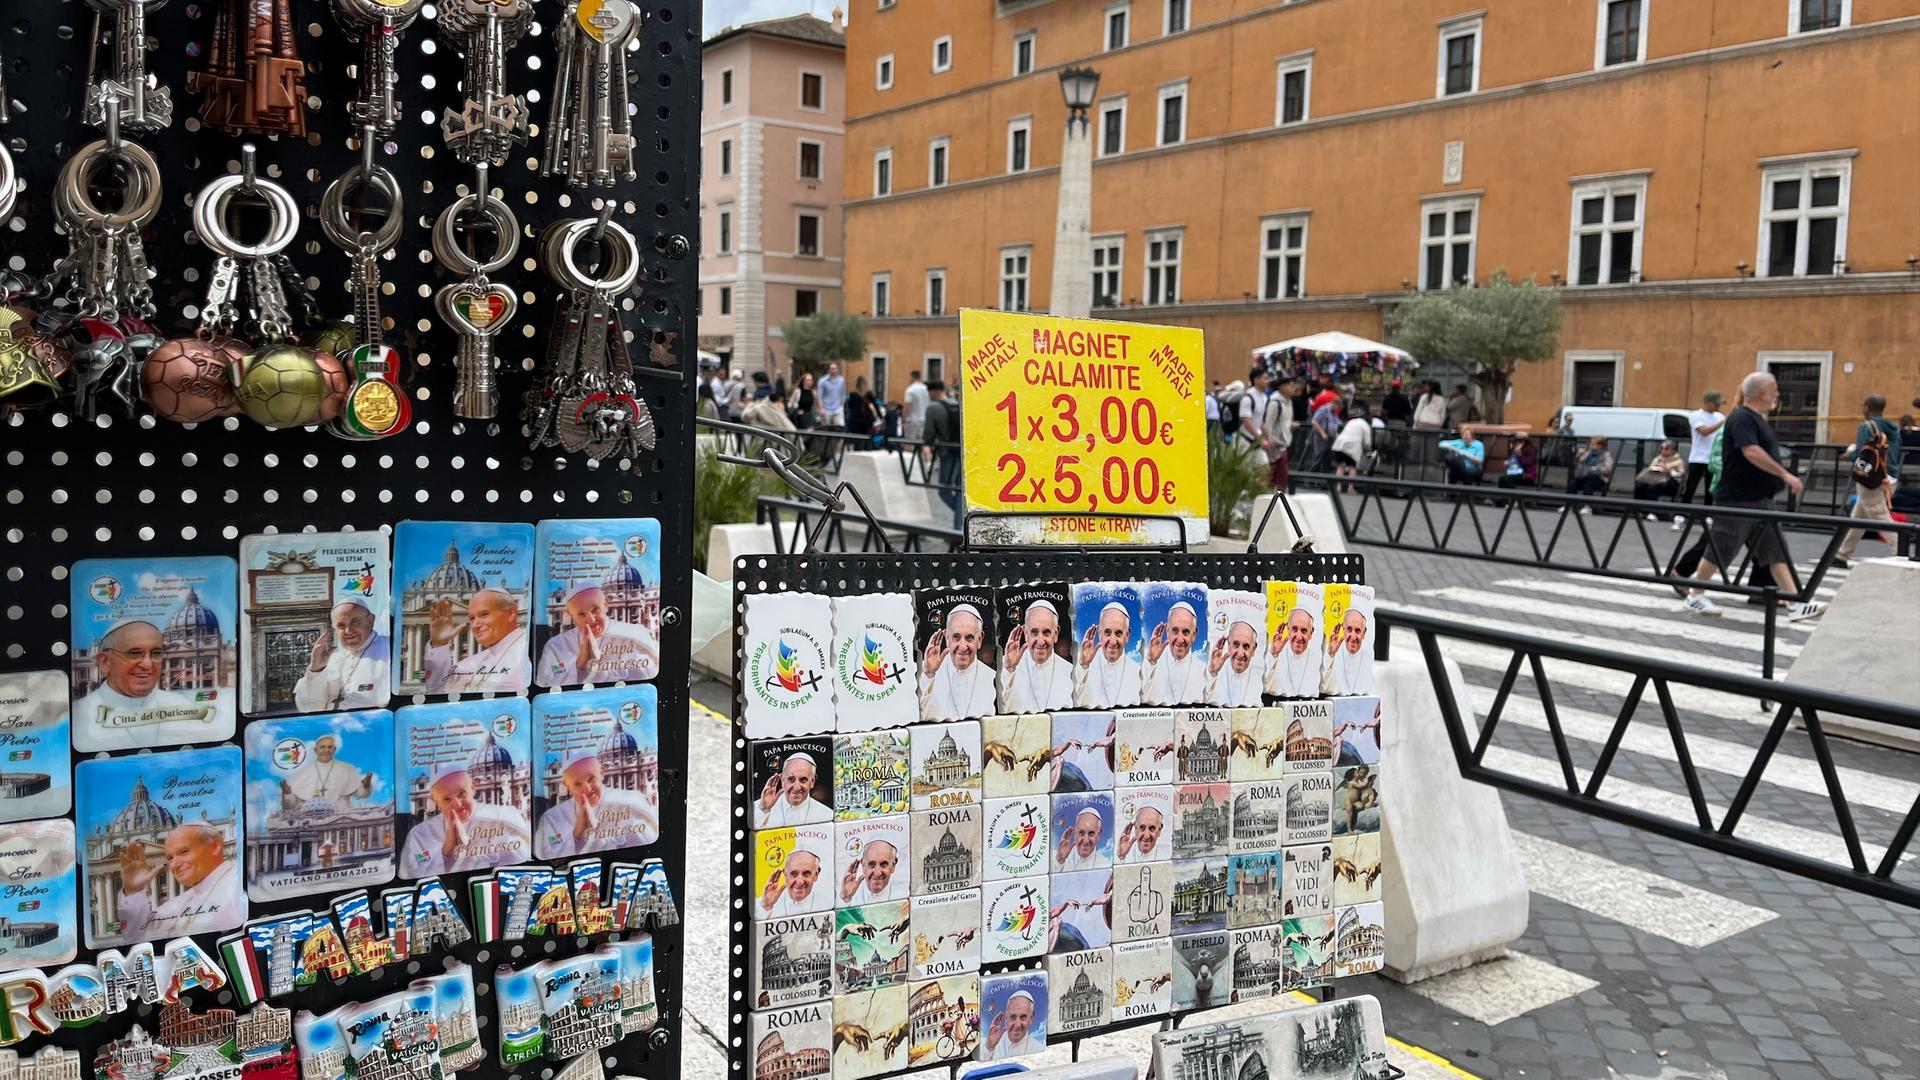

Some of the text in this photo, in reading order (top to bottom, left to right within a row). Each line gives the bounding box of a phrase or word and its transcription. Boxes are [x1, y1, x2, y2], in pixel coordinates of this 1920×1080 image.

[370, 4, 406, 17] ITALIA
[487, 29, 495, 83] ITALIA
[598, 63, 609, 99] ROMA
[466, 285, 497, 296] ROMA
[1033, 329, 1131, 360] MAGNET
[967, 333, 1006, 372] MADE
[1149, 348, 1163, 367] IN
[982, 341, 1019, 384] ITALY
[1161, 344, 1195, 385] MADE
[1023, 359, 1141, 391] CALAMITE
[1160, 362, 1192, 400] ITALY
[970, 375, 987, 391] IN
[322, 547, 376, 556] PEREGRINANTES
[344, 555, 363, 563] SPEM
[471, 555, 515, 565] la nostra
[1005, 591, 1064, 606] PAPA FRANCESCO
[1081, 590, 1135, 603] PAPA FRANCESCO
[1150, 590, 1203, 601] PAPA FRANCESCO
[1274, 586, 1320, 600] PAPA FRANCESCO
[1330, 587, 1371, 601] PAPA FRANCESCO
[926, 594, 989, 610] PAPA FRANCESCO
[1216, 597, 1264, 611] PAPA FRANCESCO
[780, 627, 825, 670] IUBILAEUM MMXXV
[865, 622, 908, 663] IUBILAEUM MMXXV
[588, 658, 649, 673] Francesco
[838, 636, 865, 701] PEREGRINANTES
[875, 684, 897, 701] SPEM
[751, 641, 813, 709] PEREGRINANTES IN SPEM
[141, 711, 153, 722] del
[156, 707, 199, 720] Vaticano
[1188, 712, 1224, 722] ROMA
[1293, 705, 1327, 718] ROMA
[0, 714, 33, 729] San
[0, 733, 40, 746] Pietro
[763, 743, 827, 757] PAPA FRANCESCO
[1292, 761, 1325, 770] COLOSSEO
[852, 766, 896, 782] ROMA
[1128, 771, 1161, 783] ROMA
[1189, 775, 1219, 783] VATICANO
[162, 775, 217, 789] Benedici
[1301, 778, 1331, 791] ROMA
[162, 788, 214, 801] la nostra
[930, 790, 974, 808] ROMA
[1122, 791, 1169, 803] PAPA FRANCESCO
[1178, 793, 1203, 806] ROMA
[1250, 786, 1281, 800] ROMA
[177, 802, 201, 810] casa
[1060, 798, 1110, 810] PAPA FRANCESCO
[928, 809, 971, 827] ROMA
[585, 824, 645, 840] Francesco
[843, 823, 904, 839] PAPA FRANCESCO
[987, 818, 997, 849] IUBILAEUM
[1288, 829, 1328, 840] IL COLOSSEO
[764, 830, 828, 847] PAPA FRANCESCO
[997, 812, 1048, 874] PEREGRINANTES IN SPEM
[1235, 839, 1277, 850] IL COLOSSEO
[454, 840, 521, 858] Francesco
[1245, 859, 1269, 871] ROMA
[1295, 860, 1320, 874] VENI
[9, 866, 42, 880] San
[4, 884, 48, 899] Pietro
[927, 880, 970, 894] SAN PIETRO
[1295, 878, 1319, 891] VIDI
[469, 859, 680, 944] ITALIA
[918, 892, 977, 906] Creazione del Gatto
[1295, 894, 1318, 908] VICI
[987, 901, 998, 932] IUBILAEUM
[764, 918, 819, 937] ROMA
[996, 893, 1048, 957] PEREGRINANTES IN SPEM
[1128, 924, 1160, 938] ROMA
[219, 879, 472, 1008] ITALIA
[1182, 936, 1225, 950] IL PISELLO
[1235, 929, 1272, 945] ROMA
[1119, 944, 1145, 953] Creazione
[1065, 953, 1104, 967] ROMA
[926, 961, 965, 975] ROMA
[1347, 960, 1378, 975] ROMA
[545, 970, 581, 998] Roma
[990, 980, 1044, 995] PAPA FRANCESCO
[0, 938, 226, 1048] ROMA
[772, 988, 817, 1002] IL COLOSSEO
[1245, 987, 1271, 998] COLOSSEO
[580, 1002, 620, 1016] VATICANO
[1125, 1003, 1158, 1017] ROMA
[767, 1006, 822, 1030] ROMA
[1062, 1018, 1100, 1031] SAN PIETRO
[348, 1011, 391, 1044] Roma
[391, 1042, 437, 1060] VATICANO
[561, 1035, 611, 1056] COLOSSEO
[1361, 1051, 1386, 1064] San Pietro
